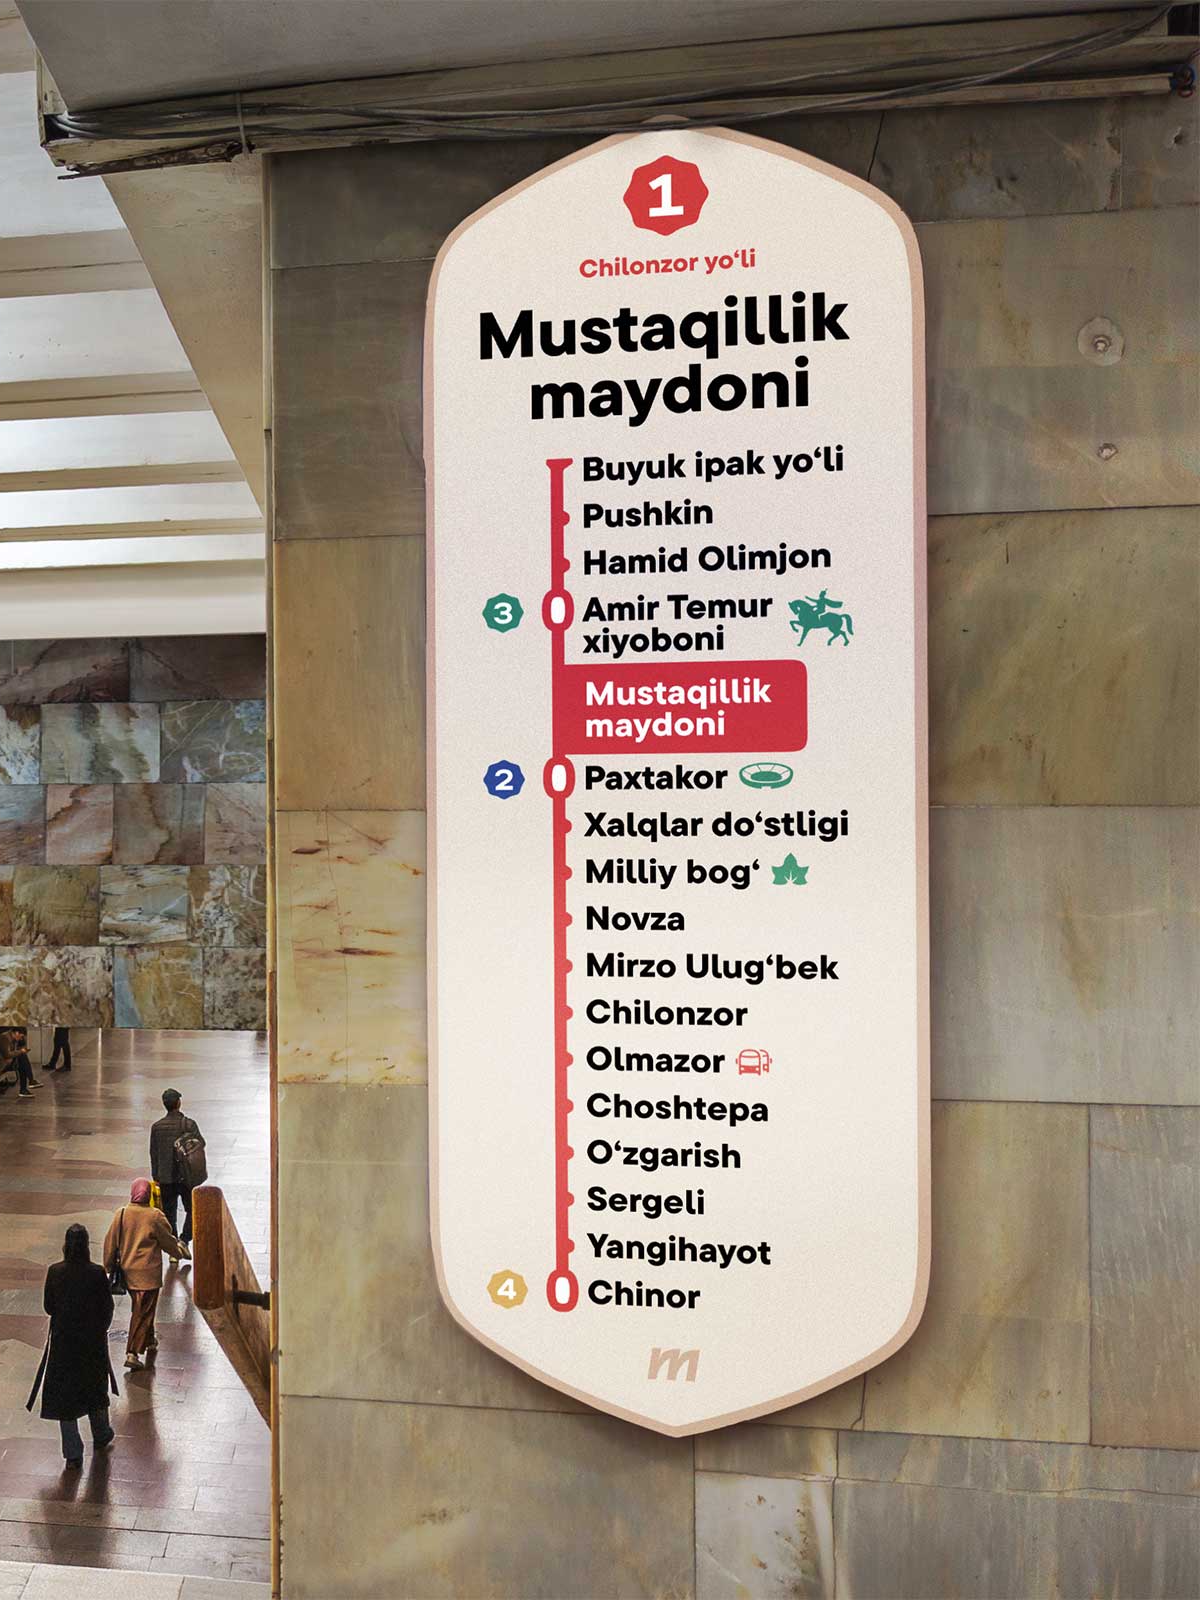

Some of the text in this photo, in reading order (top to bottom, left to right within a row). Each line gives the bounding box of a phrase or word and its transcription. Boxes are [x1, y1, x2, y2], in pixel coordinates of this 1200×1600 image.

[649, 174, 683, 216] 1
[579, 257, 699, 278] Chilonzor
[480, 291, 849, 359] Mustaqillik
[531, 355, 810, 427] maydoni
[584, 453, 686, 485] Buyuk
[696, 450, 765, 482] ipak
[584, 499, 713, 528] Pushkin
[584, 543, 831, 575] Hamid Olimjon
[495, 603, 512, 624] 3
[583, 595, 772, 622] Amir Temur
[583, 625, 724, 658] xiyoboni
[587, 678, 771, 709] Mustaqillik
[587, 710, 725, 742] maydoni
[495, 769, 513, 790] 2
[586, 765, 728, 790] Paxtakor
[584, 812, 703, 842] Xalqlar
[586, 858, 677, 889] Milliy
[587, 906, 684, 931] Novza
[587, 952, 676, 978] Mirzo
[586, 999, 748, 1026] Chilonzor
[587, 1046, 725, 1073] Olmazor
[587, 1093, 768, 1126] Choshtepa
[588, 1187, 704, 1219] Sergeli
[587, 1233, 770, 1269] Yangihayot
[498, 1279, 516, 1299] 4
[588, 1280, 700, 1308] Chinor
